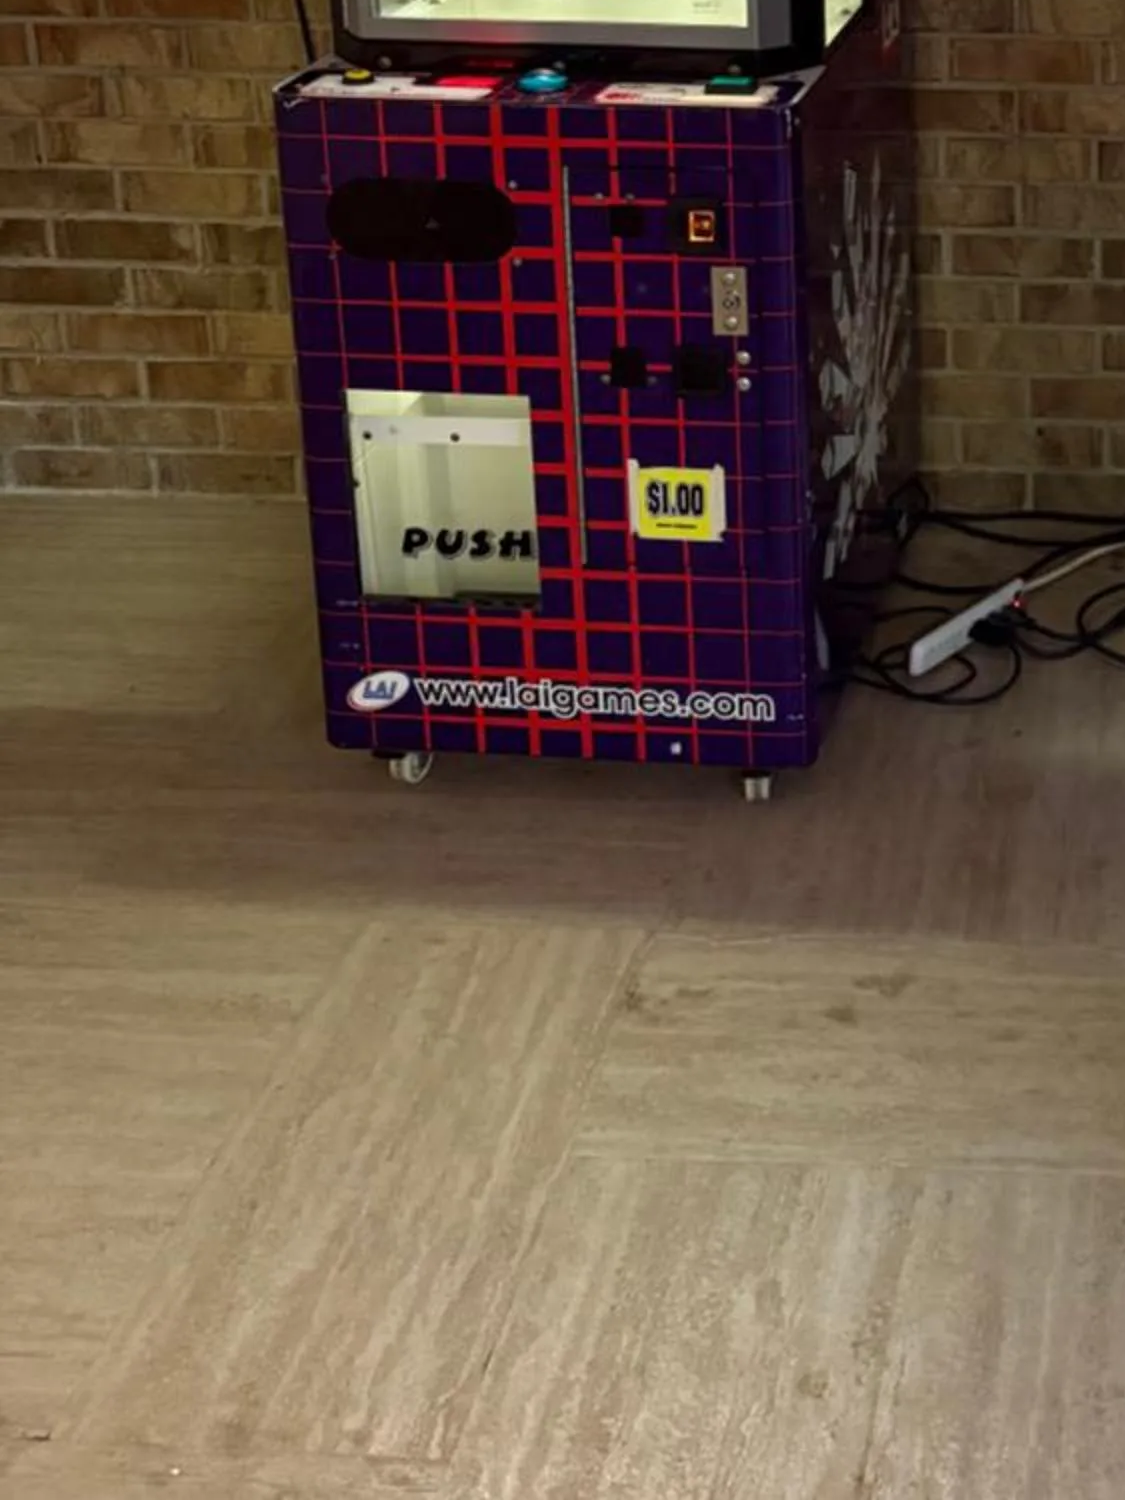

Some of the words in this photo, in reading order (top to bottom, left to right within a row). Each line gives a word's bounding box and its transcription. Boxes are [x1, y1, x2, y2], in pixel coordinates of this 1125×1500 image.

[646, 480, 705, 517] $1.00
[402, 527, 537, 561] PUSH
[361, 679, 398, 701] LAI
[414, 676, 776, 721] www.laigames.com
